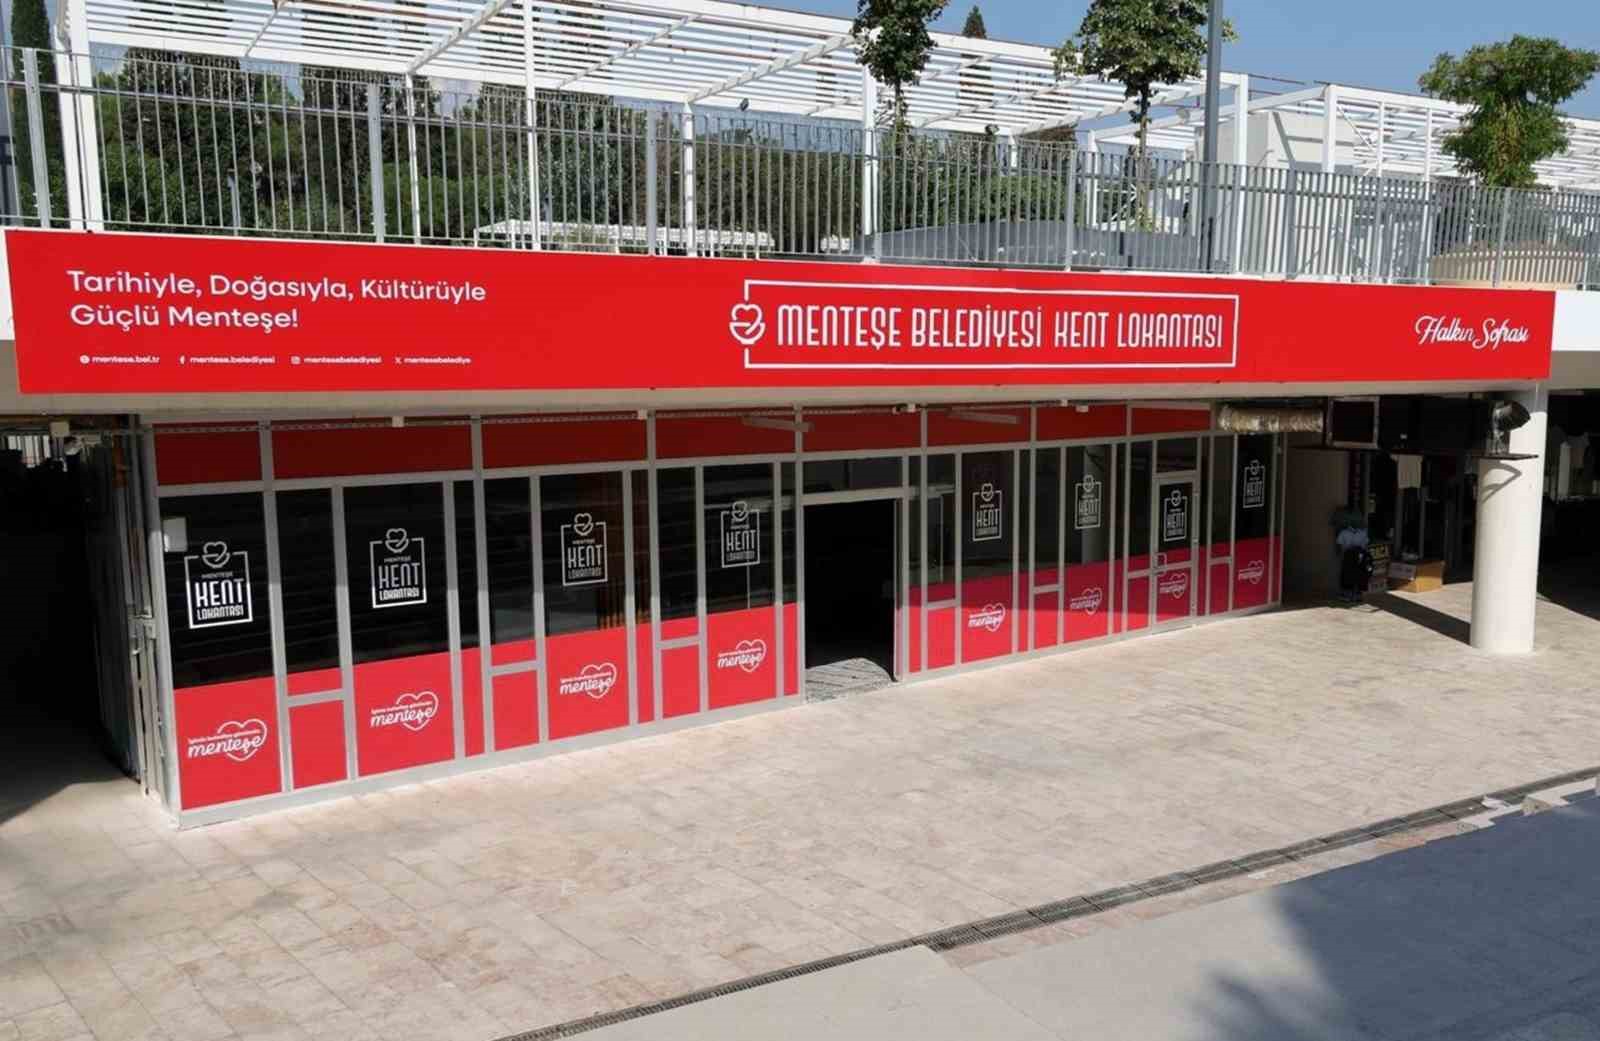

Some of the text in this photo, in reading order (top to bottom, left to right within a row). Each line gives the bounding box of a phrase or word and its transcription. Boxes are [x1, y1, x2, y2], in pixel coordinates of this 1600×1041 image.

[66, 270, 487, 304] Tarihiyle, Doğasıyla, Kültürüyle
[70, 304, 298, 334] Güçlü Menteşe!
[777, 303, 1223, 350] MENTEŞE BELEDİYESİ KENT LOKANTASI
[1415, 314, 1529, 350] Halkın Sofrası
[726, 530, 757, 552] KENT
[567, 544, 603, 569] KENT
[377, 562, 421, 589] KENT
[194, 578, 245, 607] KENT
[196, 604, 244, 620] LOKANTASI
[370, 707, 434, 728] menteşe
[187, 734, 263, 758] menteşe
